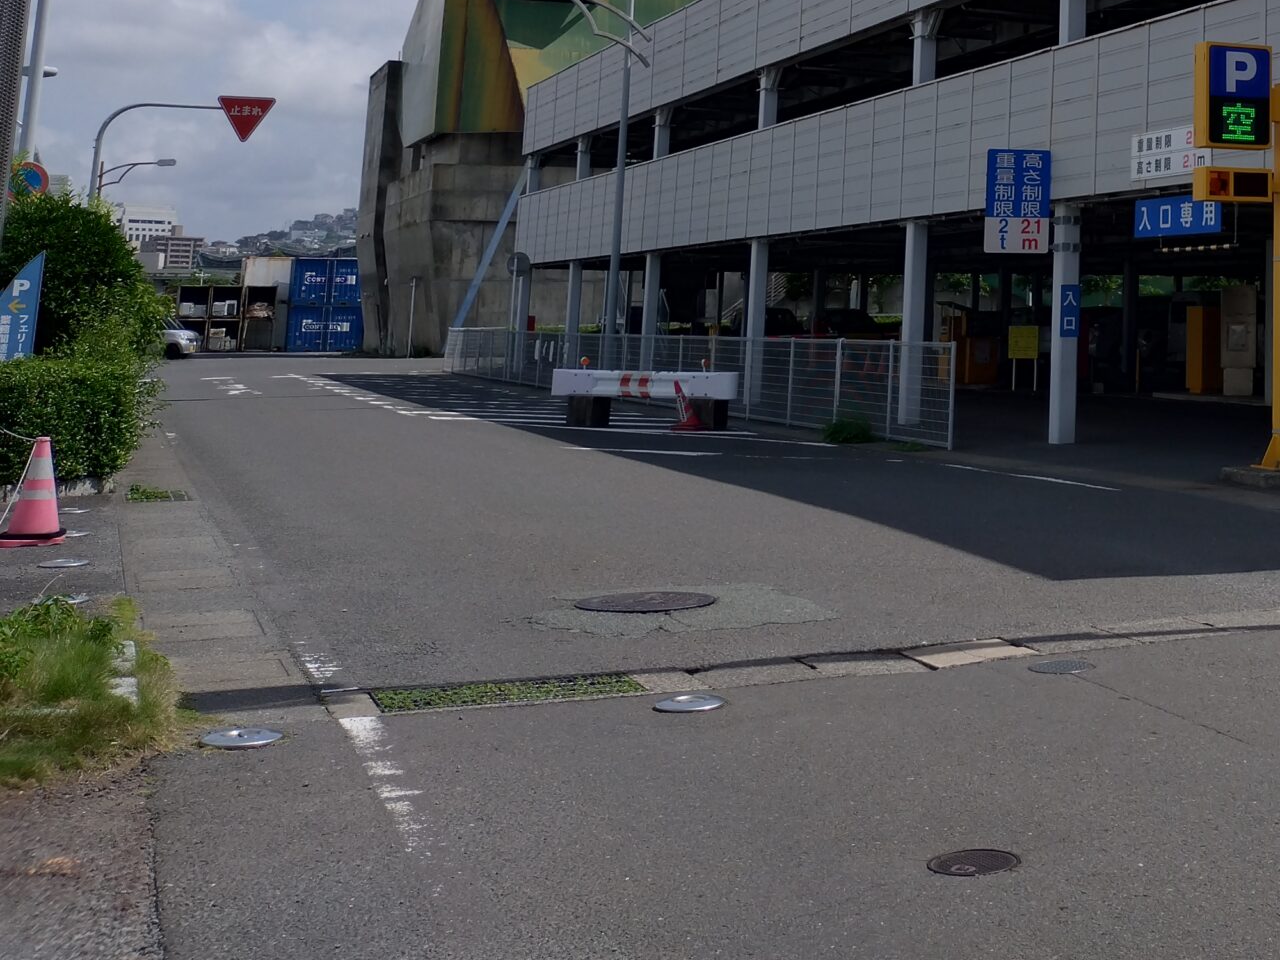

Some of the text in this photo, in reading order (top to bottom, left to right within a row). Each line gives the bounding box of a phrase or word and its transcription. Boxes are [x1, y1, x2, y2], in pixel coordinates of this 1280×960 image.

[1225, 51, 1257, 92] P
[230, 105, 262, 116] 止まれ
[1222, 103, 1255, 140] 空
[1137, 134, 1172, 153] 重量制限
[1136, 157, 1171, 175] 高さ制限
[994, 153, 1016, 249] 重量制限 2 t
[1021, 153, 1043, 250] 高さ制限 2.1 m
[1139, 201, 1215, 230] 入口専用
[12, 279, 31, 297] P
[1063, 291, 1077, 330] 入口
